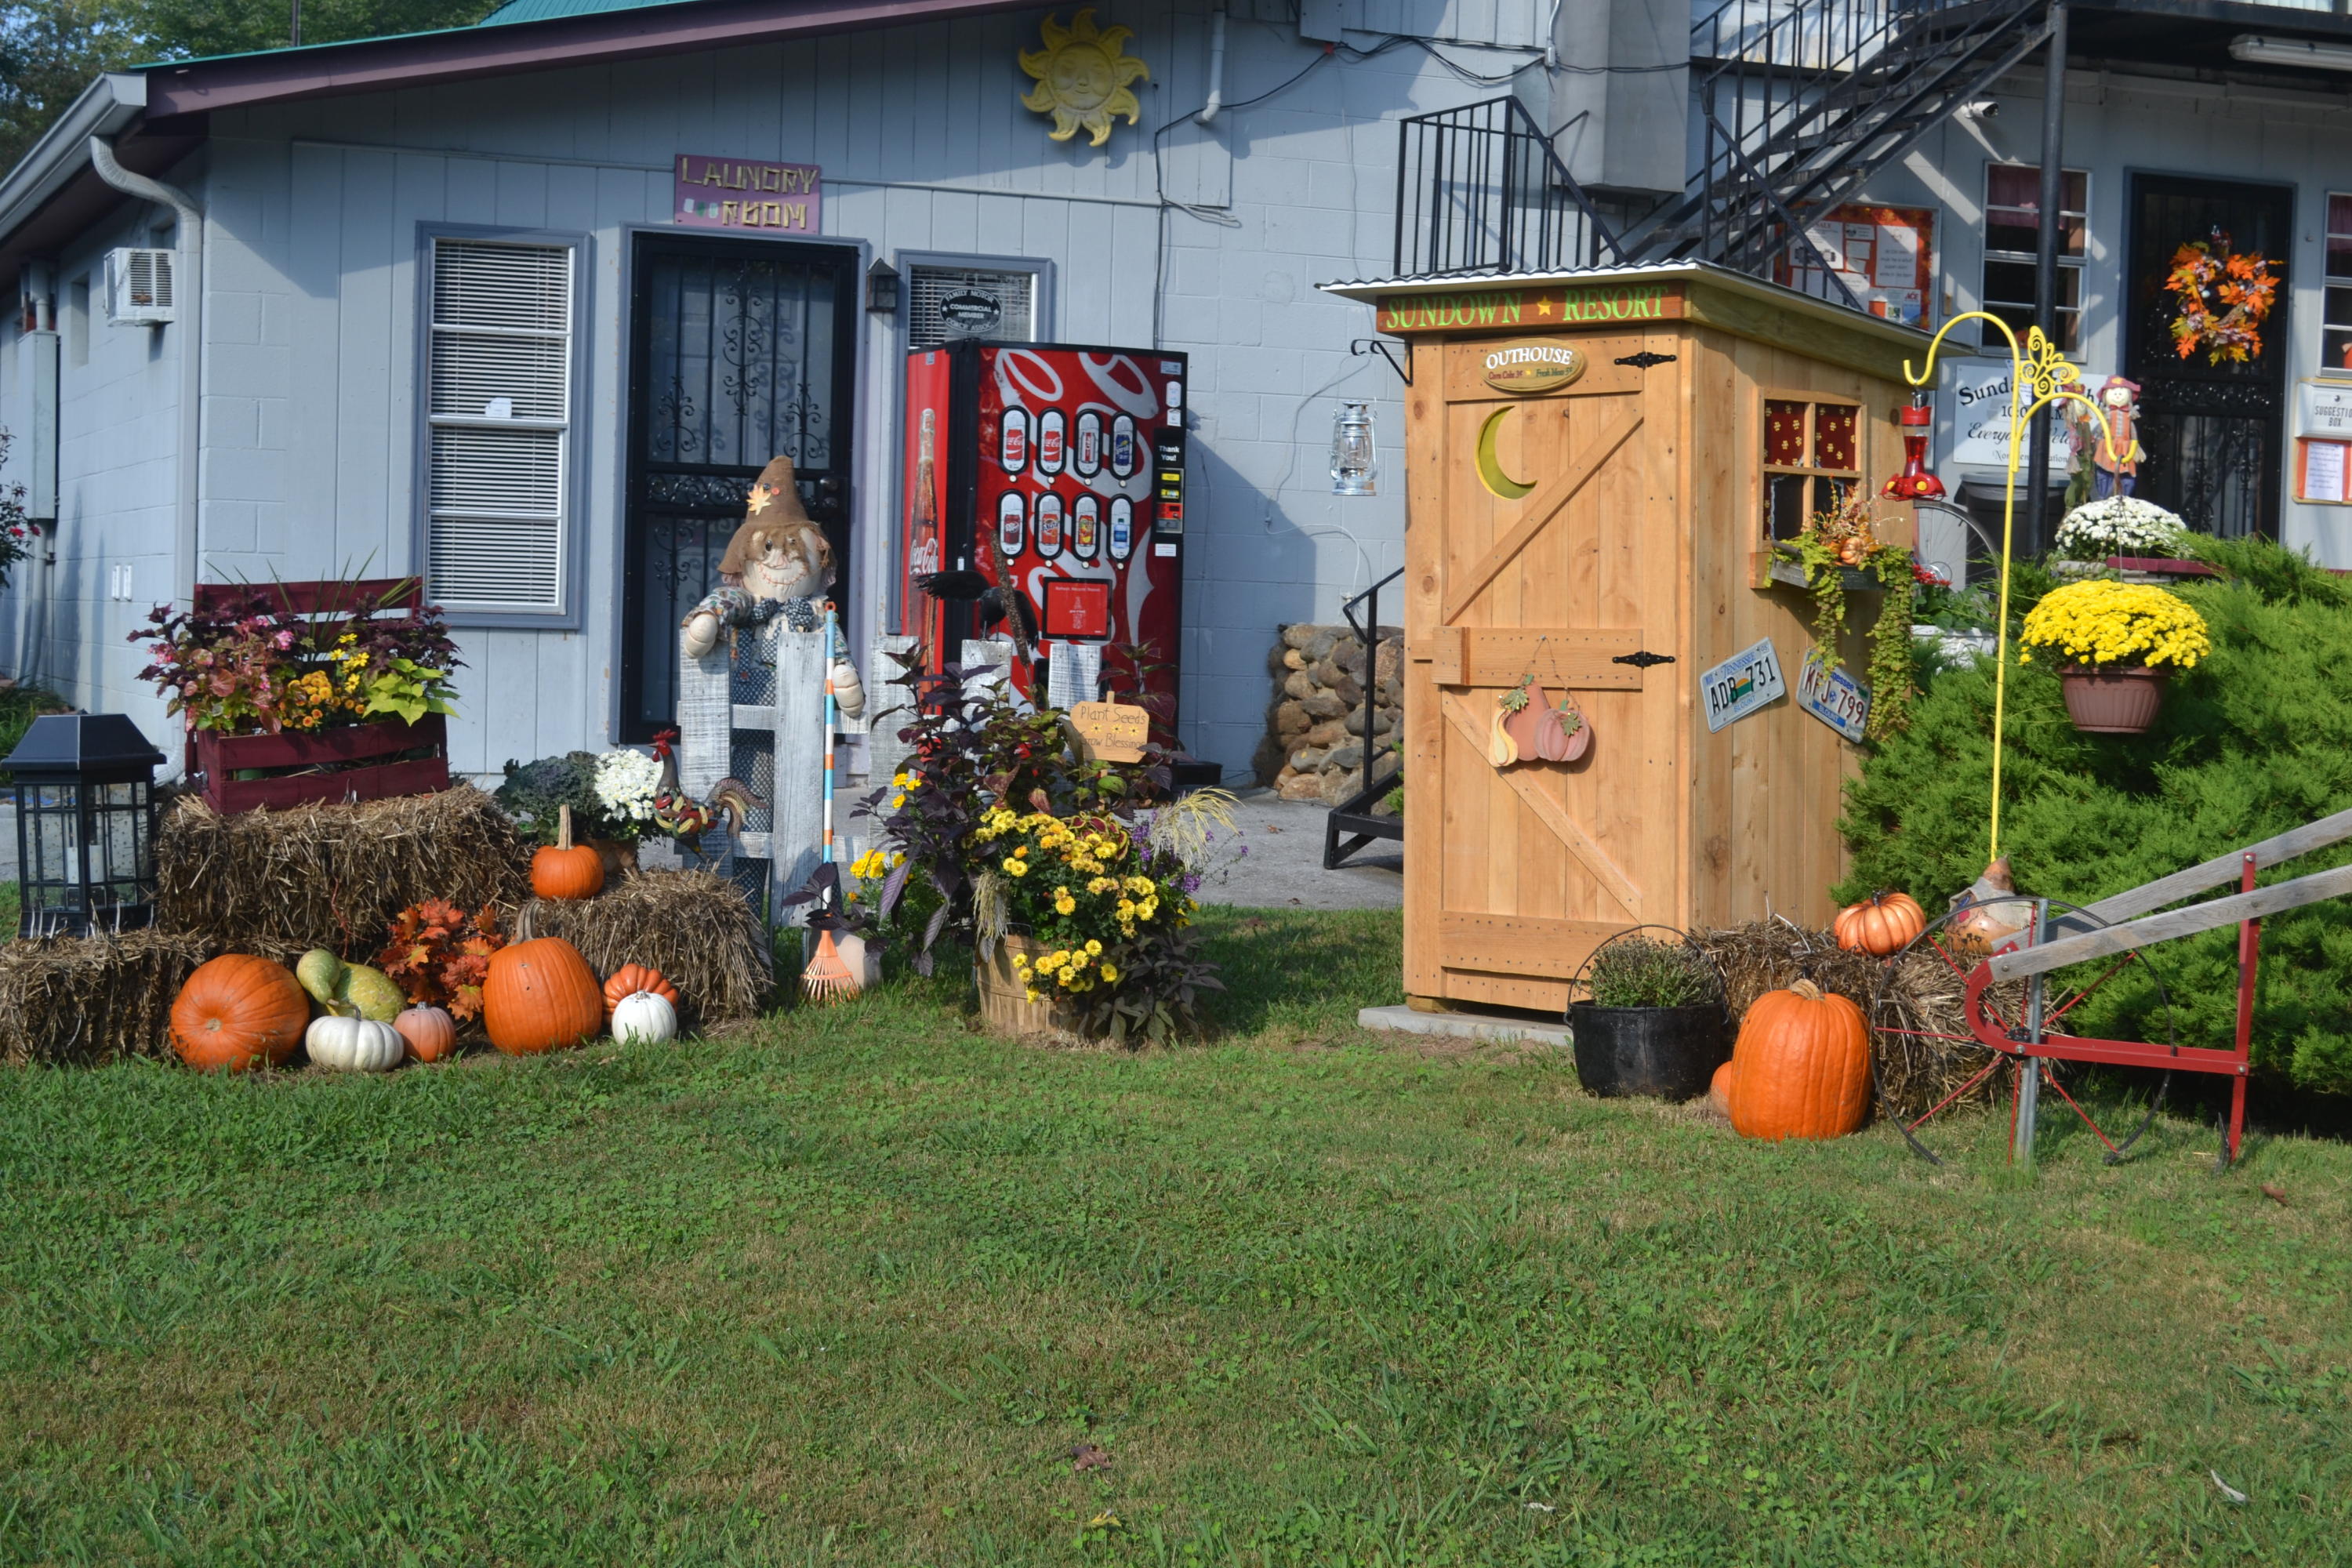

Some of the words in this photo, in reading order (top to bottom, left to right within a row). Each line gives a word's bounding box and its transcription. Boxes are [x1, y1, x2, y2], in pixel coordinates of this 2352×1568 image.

[681, 158, 818, 194] LAUNDRY
[722, 201, 806, 229] ROOM
[970, 290, 994, 303] MOTOR
[1386, 292, 1523, 329] SUNDOWN
[1563, 285, 1669, 321] RESORT
[949, 303, 992, 312] COMMERCIAL
[1486, 347, 1573, 368] OUTHOUSE
[1958, 376, 2015, 406] Sund
[2314, 405, 2352, 418] SUGGESTIO
[2328, 417, 2341, 427] BOX
[1160, 445, 1180, 453] Thank
[1711, 677, 1739, 715] ADB
[1745, 657, 1776, 691] 731
[1805, 666, 1831, 703] KFJ
[1838, 688, 1864, 724] 799
[1080, 706, 1110, 721] Plant
[1113, 706, 1146, 724] Seeds
